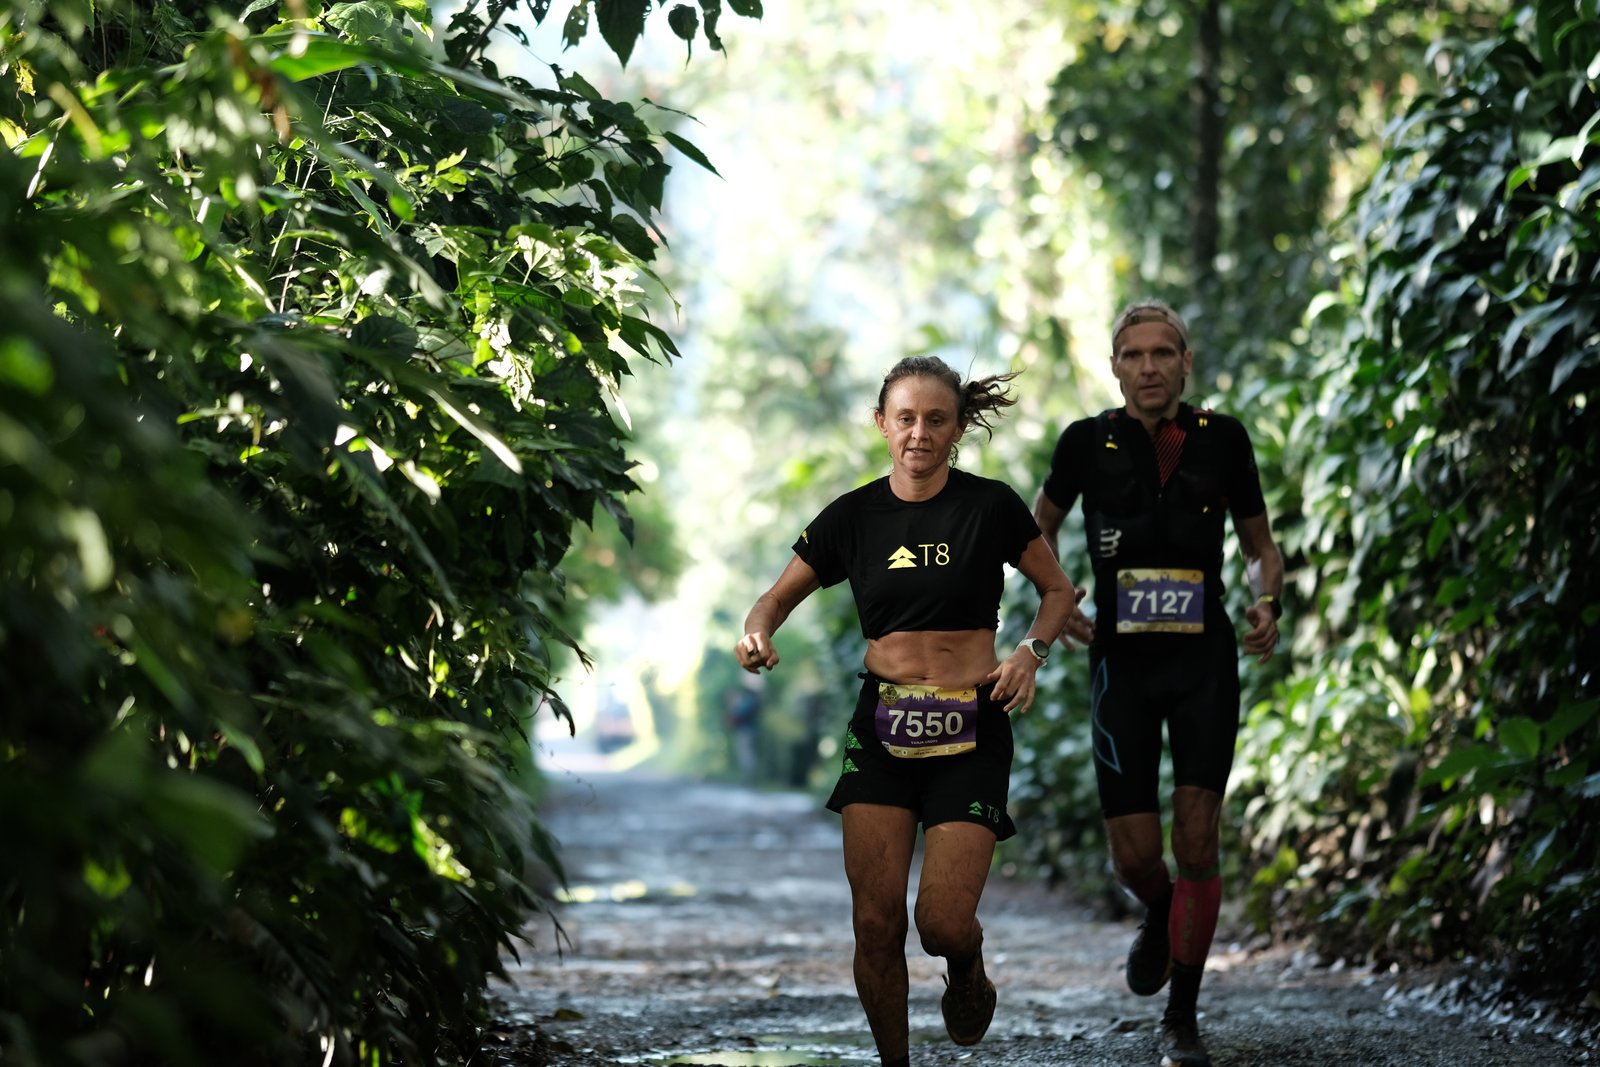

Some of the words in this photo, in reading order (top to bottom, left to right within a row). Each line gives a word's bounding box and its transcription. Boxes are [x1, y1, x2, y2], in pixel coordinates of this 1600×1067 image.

[917, 543, 950, 567] T8
[1128, 590, 1194, 615] 7127
[888, 709, 963, 738] 7550
[986, 804, 1000, 824] T8
